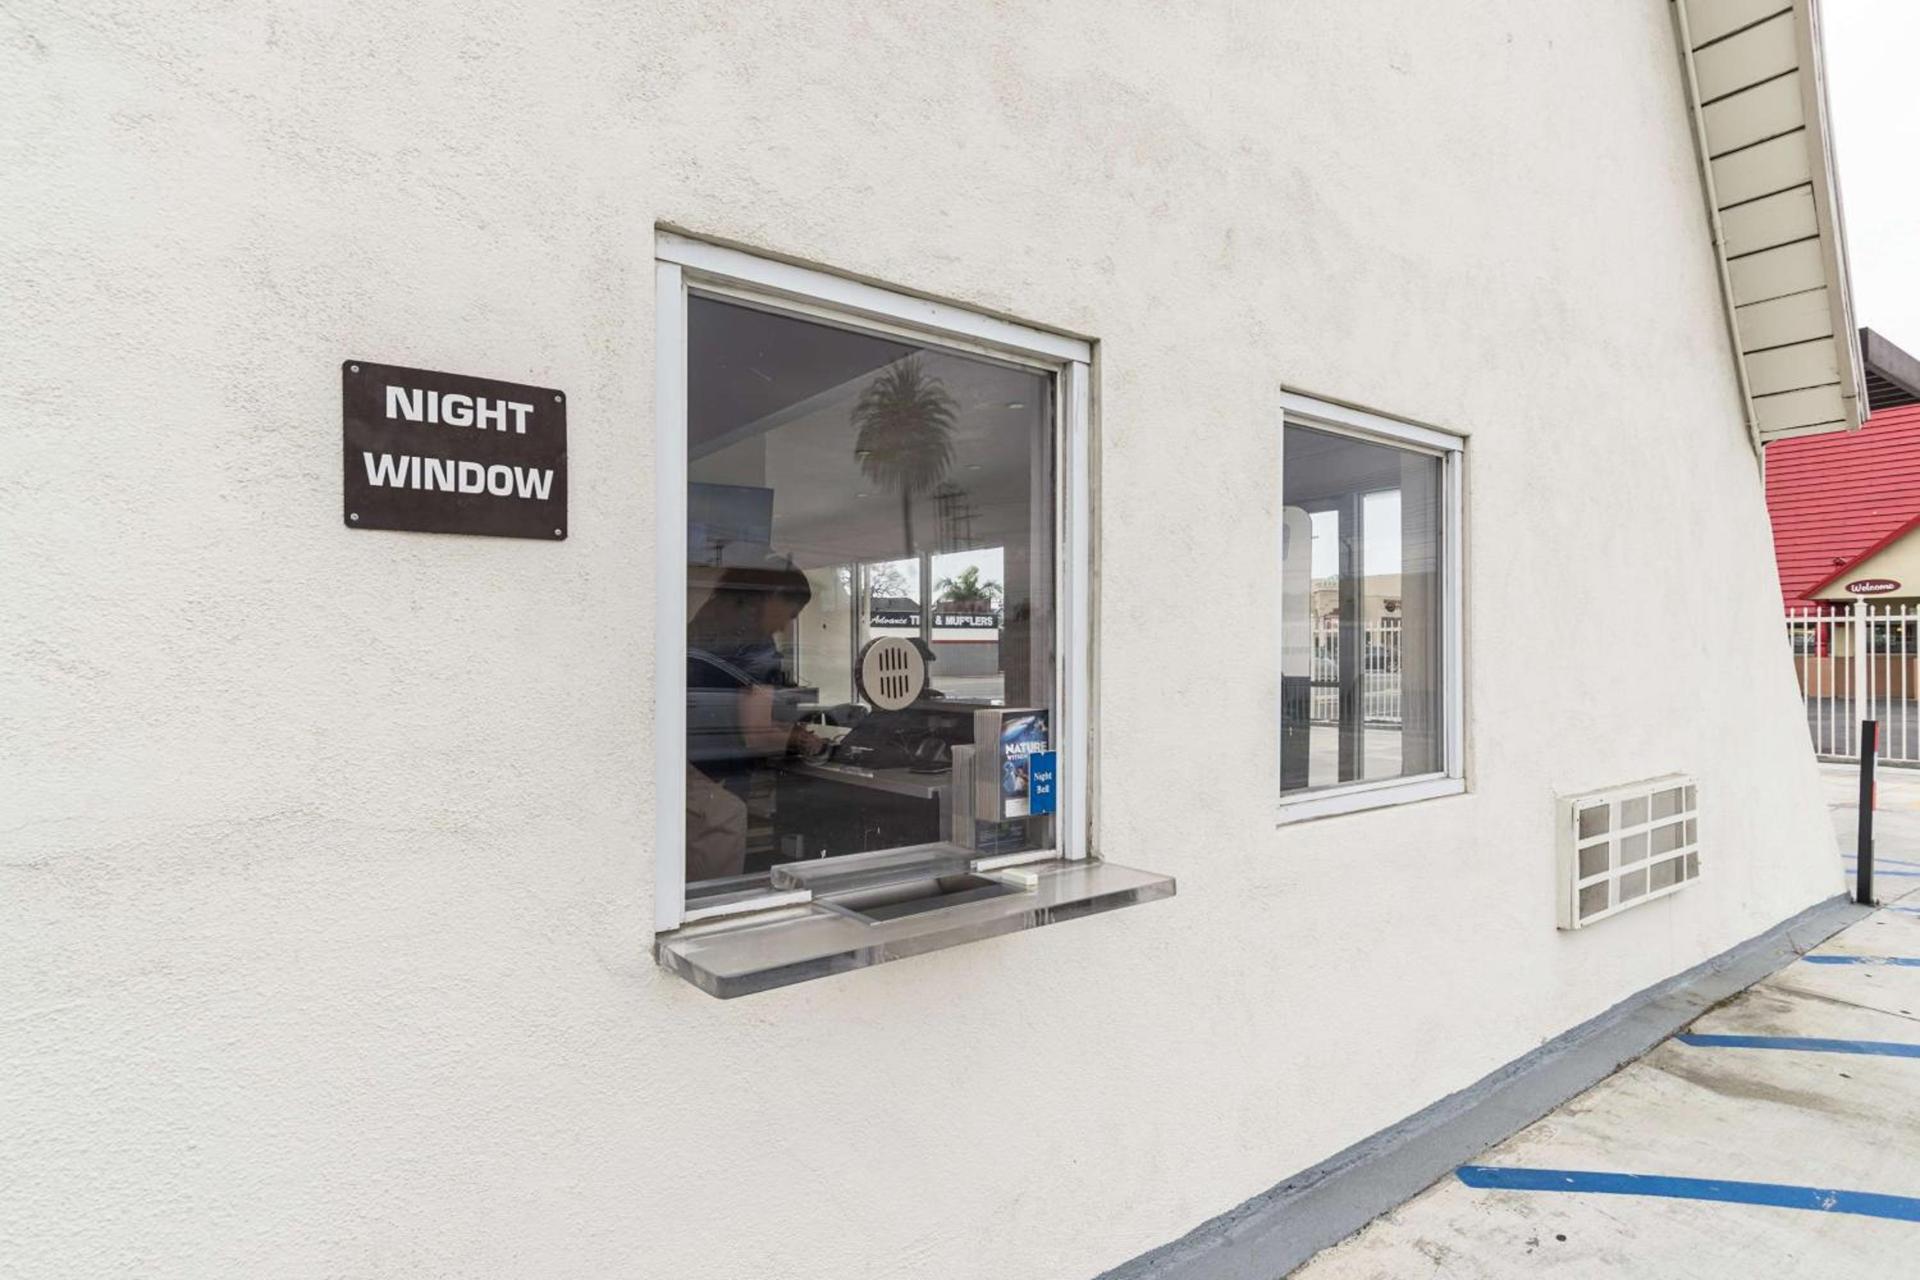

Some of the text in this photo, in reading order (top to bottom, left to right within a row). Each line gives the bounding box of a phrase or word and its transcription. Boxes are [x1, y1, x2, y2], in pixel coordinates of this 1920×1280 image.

[386, 385, 534, 434] NIGHT
[363, 452, 554, 500] WINDOW
[1851, 582, 1895, 592] Welcome
[935, 615, 942, 626] &
[1005, 741, 1048, 755] NATURE
[1034, 771, 1052, 782] Night
[1036, 784, 1050, 794] Bell
